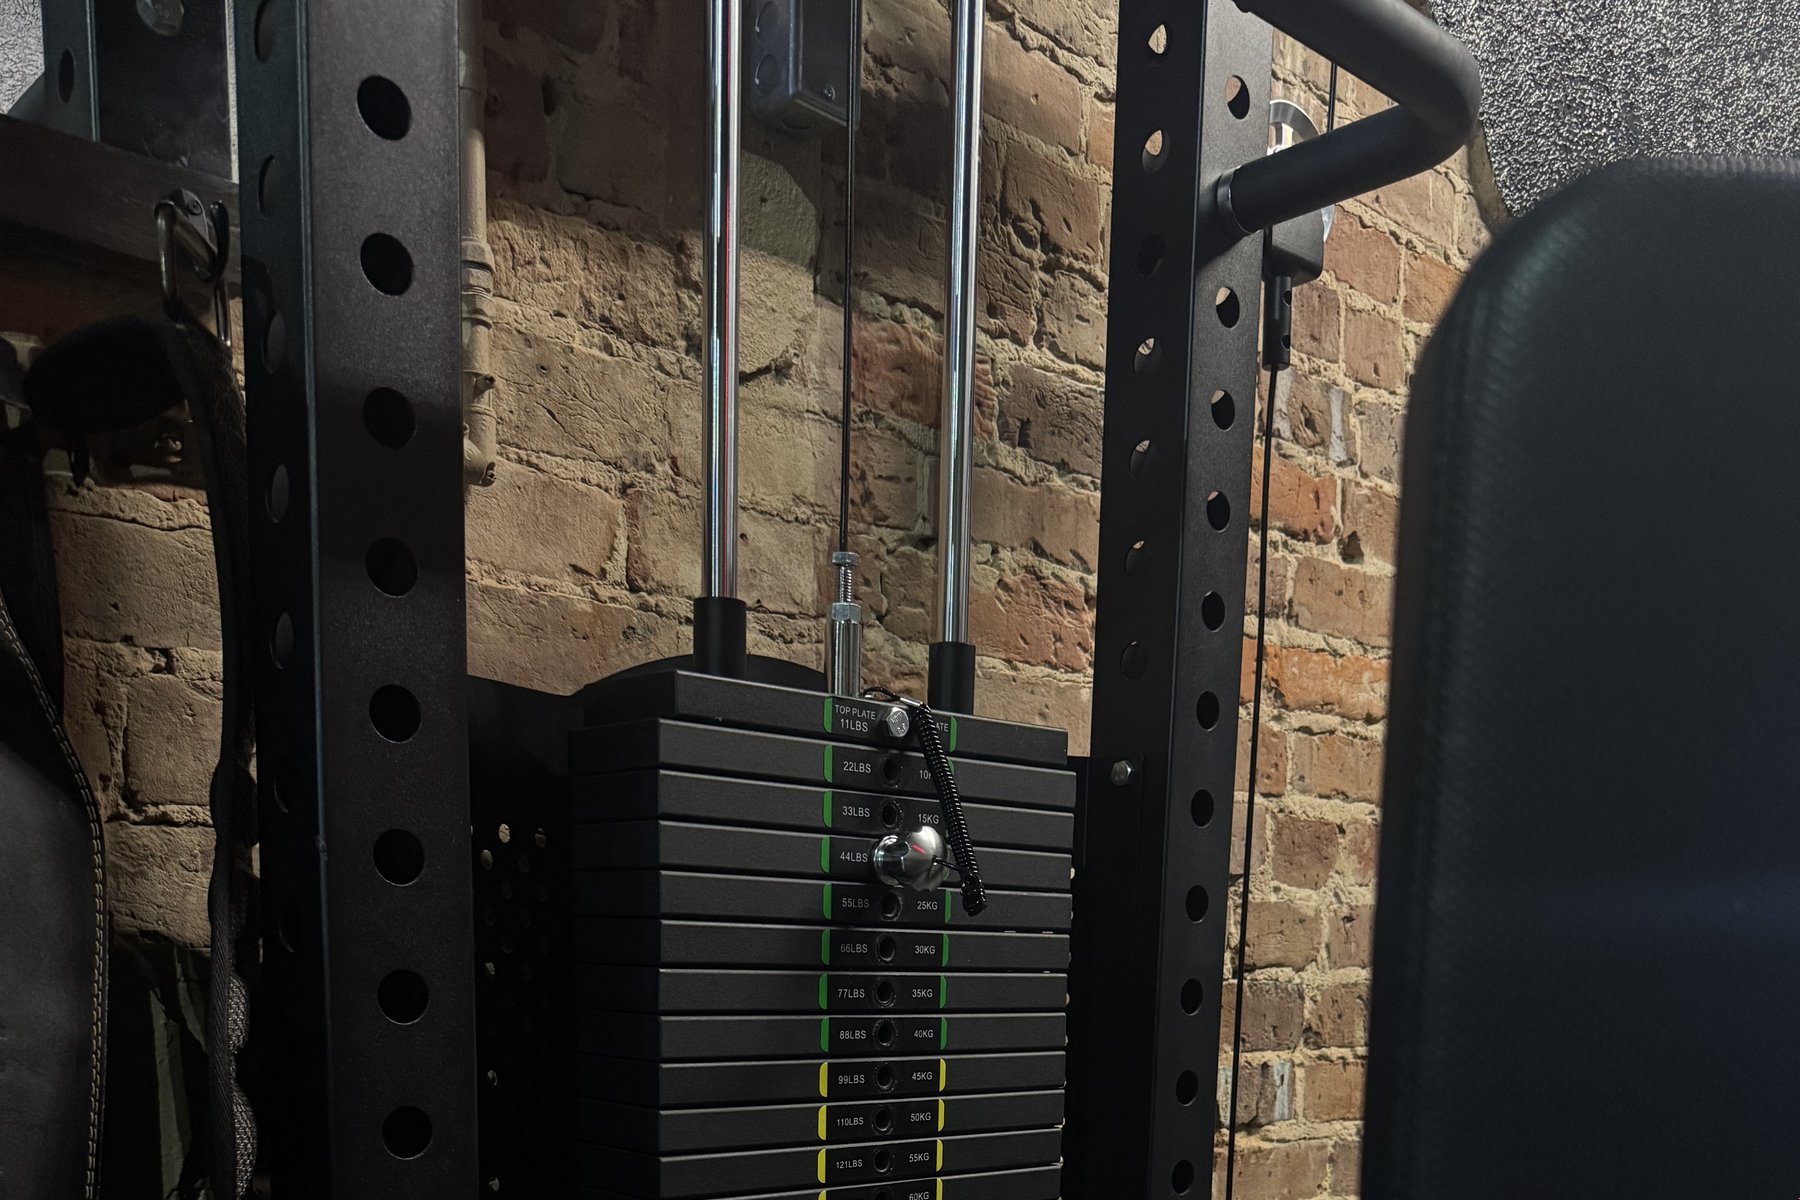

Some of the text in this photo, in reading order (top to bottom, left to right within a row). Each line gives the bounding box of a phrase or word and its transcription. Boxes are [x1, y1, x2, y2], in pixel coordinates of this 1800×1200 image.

[834, 704, 850, 715] TOP
[852, 707, 876, 720] PLATE
[840, 718, 869, 733] 11LBS
[936, 723, 948, 731] ATE
[843, 760, 872, 774] 22LBS
[842, 805, 871, 818] 33LBS
[918, 813, 940, 825] 15KG
[839, 851, 868, 863] 44LBS
[841, 897, 870, 909] 55LBS
[917, 900, 938, 911] 25KG
[840, 943, 868, 954] 66LBS
[914, 944, 936, 955] 30KG
[837, 988, 865, 999] 77LBS
[911, 988, 933, 998] 35KG
[839, 1029, 867, 1040] 88LBS
[913, 1029, 934, 1038] 40KG
[838, 1074, 866, 1085] 99LBS
[911, 1071, 933, 1081] 45KG
[836, 1116, 864, 1127] 110LBS
[910, 1111, 932, 1122] 50KG
[908, 1152, 930, 1163] 55KG
[836, 1159, 863, 1169] 121LBS
